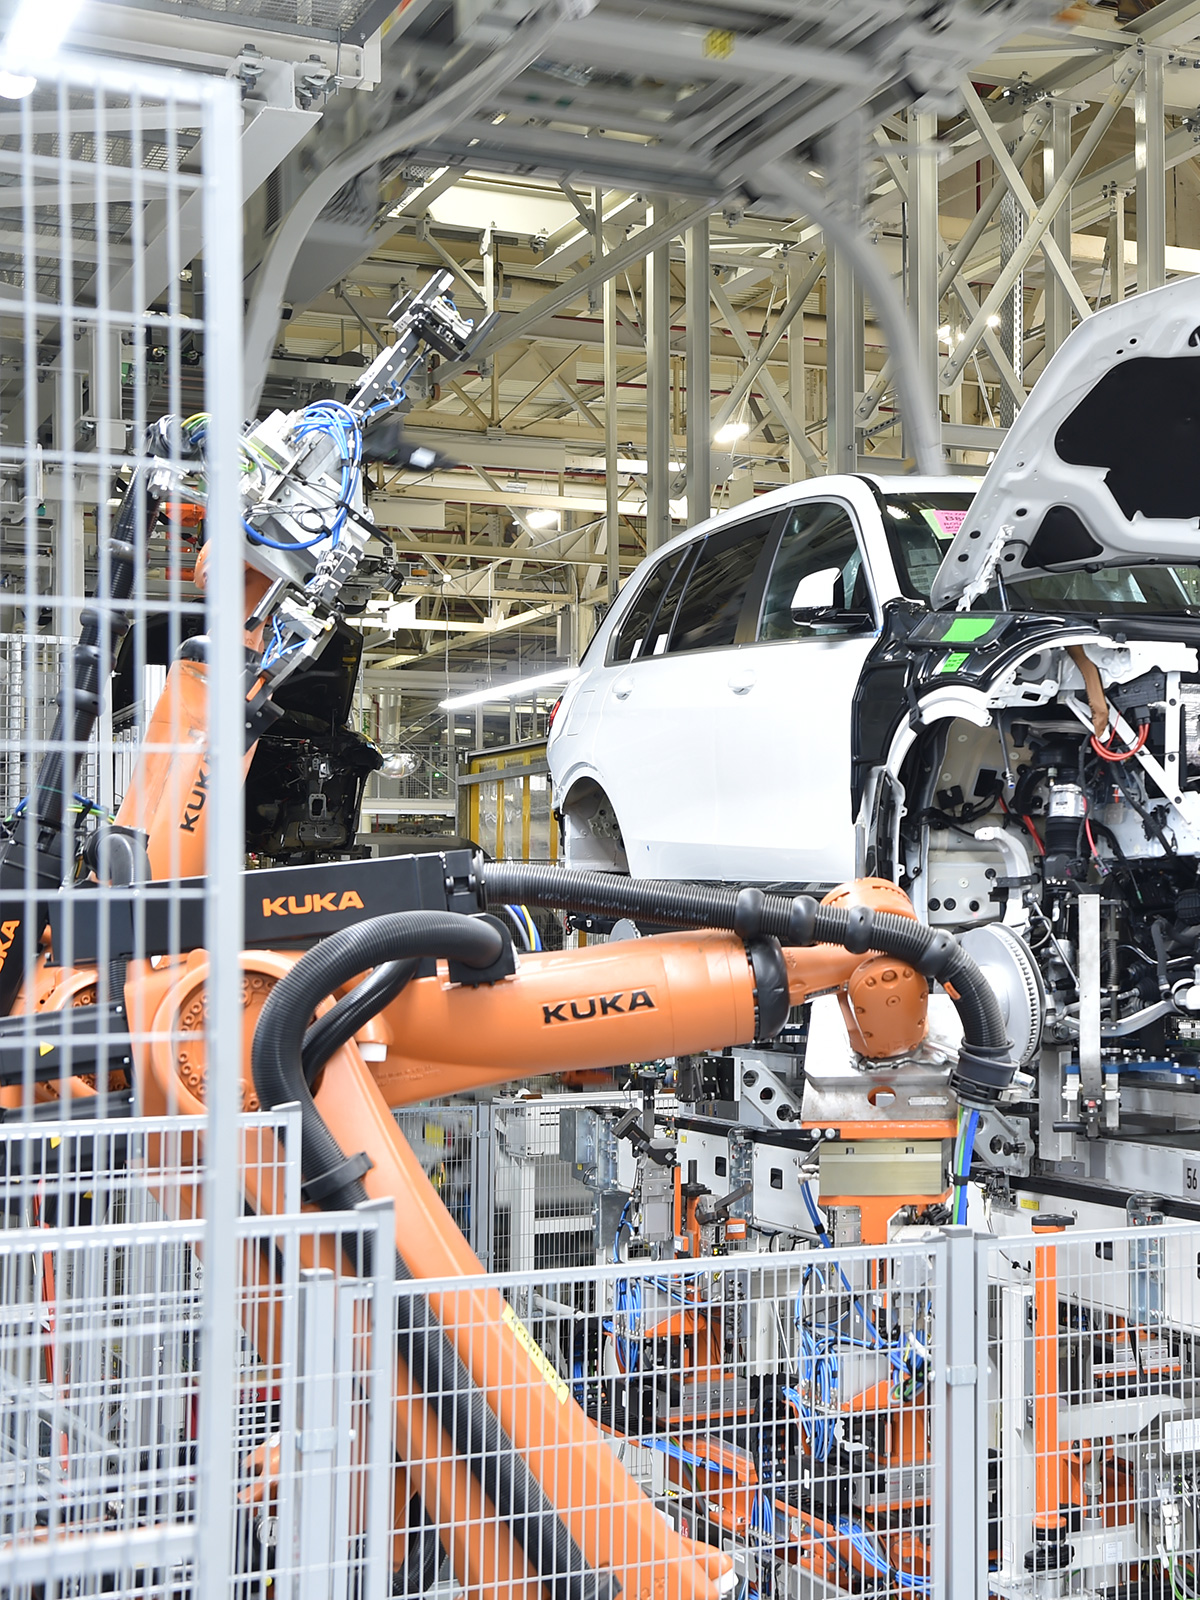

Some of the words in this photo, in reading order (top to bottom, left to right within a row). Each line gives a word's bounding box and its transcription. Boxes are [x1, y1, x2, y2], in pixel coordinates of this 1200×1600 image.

[179, 752, 212, 833] KUK
[262, 890, 365, 917] KUKA
[0, 920, 20, 973] KA
[542, 990, 656, 1024] KUKA
[1186, 1167, 1198, 1190] 56
